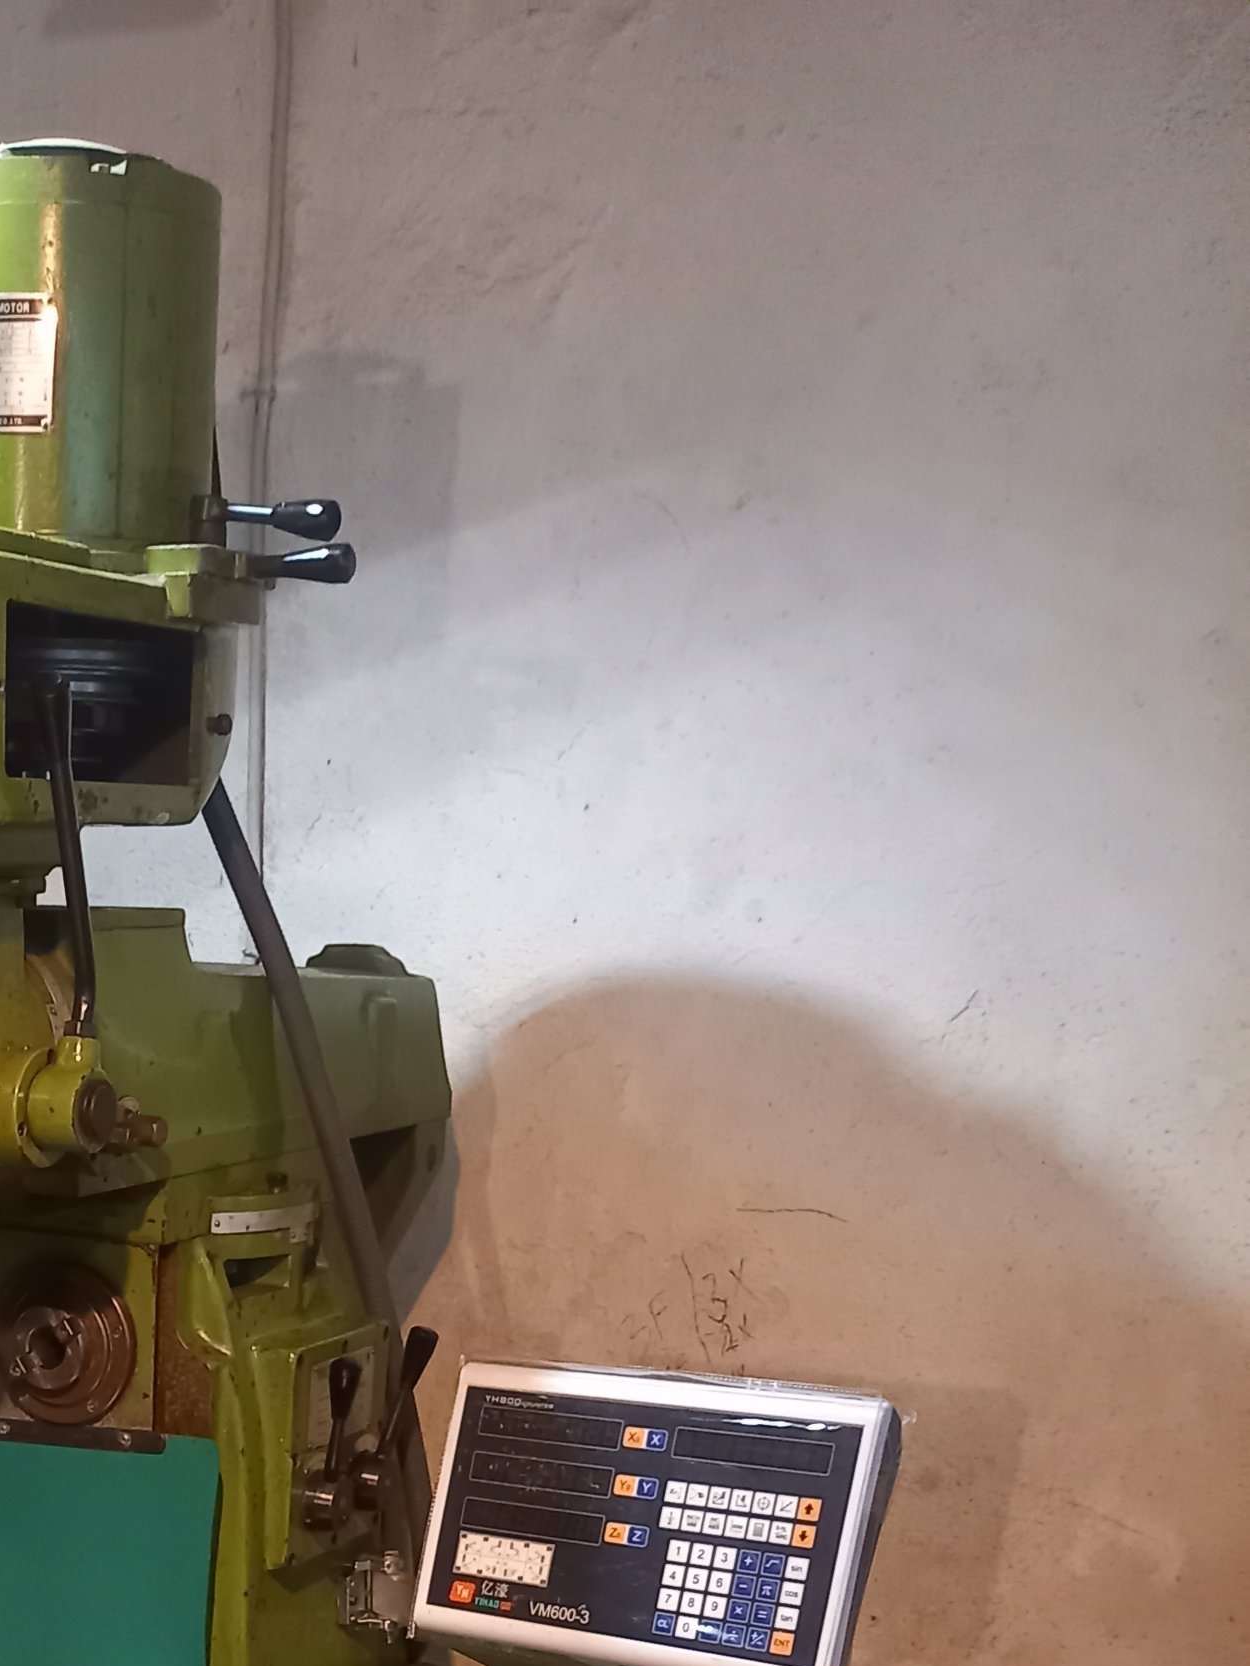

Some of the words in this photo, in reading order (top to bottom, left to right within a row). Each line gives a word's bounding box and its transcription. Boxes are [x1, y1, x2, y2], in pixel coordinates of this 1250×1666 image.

[650, 1433, 662, 1446] X
[642, 1482, 653, 1495] Y
[632, 1530, 643, 1542] Z
[676, 1546, 681, 1556] 1
[697, 1549, 705, 1560] 2
[720, 1552, 728, 1563] 3
[791, 1565, 803, 1573] sin
[669, 1571, 677, 1581] 4
[692, 1574, 700, 1584] 5
[715, 1577, 723, 1588] 6
[784, 1590, 799, 1598] cos
[529, 1600, 590, 1625] VM600-3
[664, 1593, 673, 1604] 7
[687, 1597, 695, 1608] 8
[711, 1601, 719, 1612] 9
[780, 1614, 793, 1622] tan
[682, 1622, 690, 1633] 0
[773, 1639, 791, 1649] ENT
